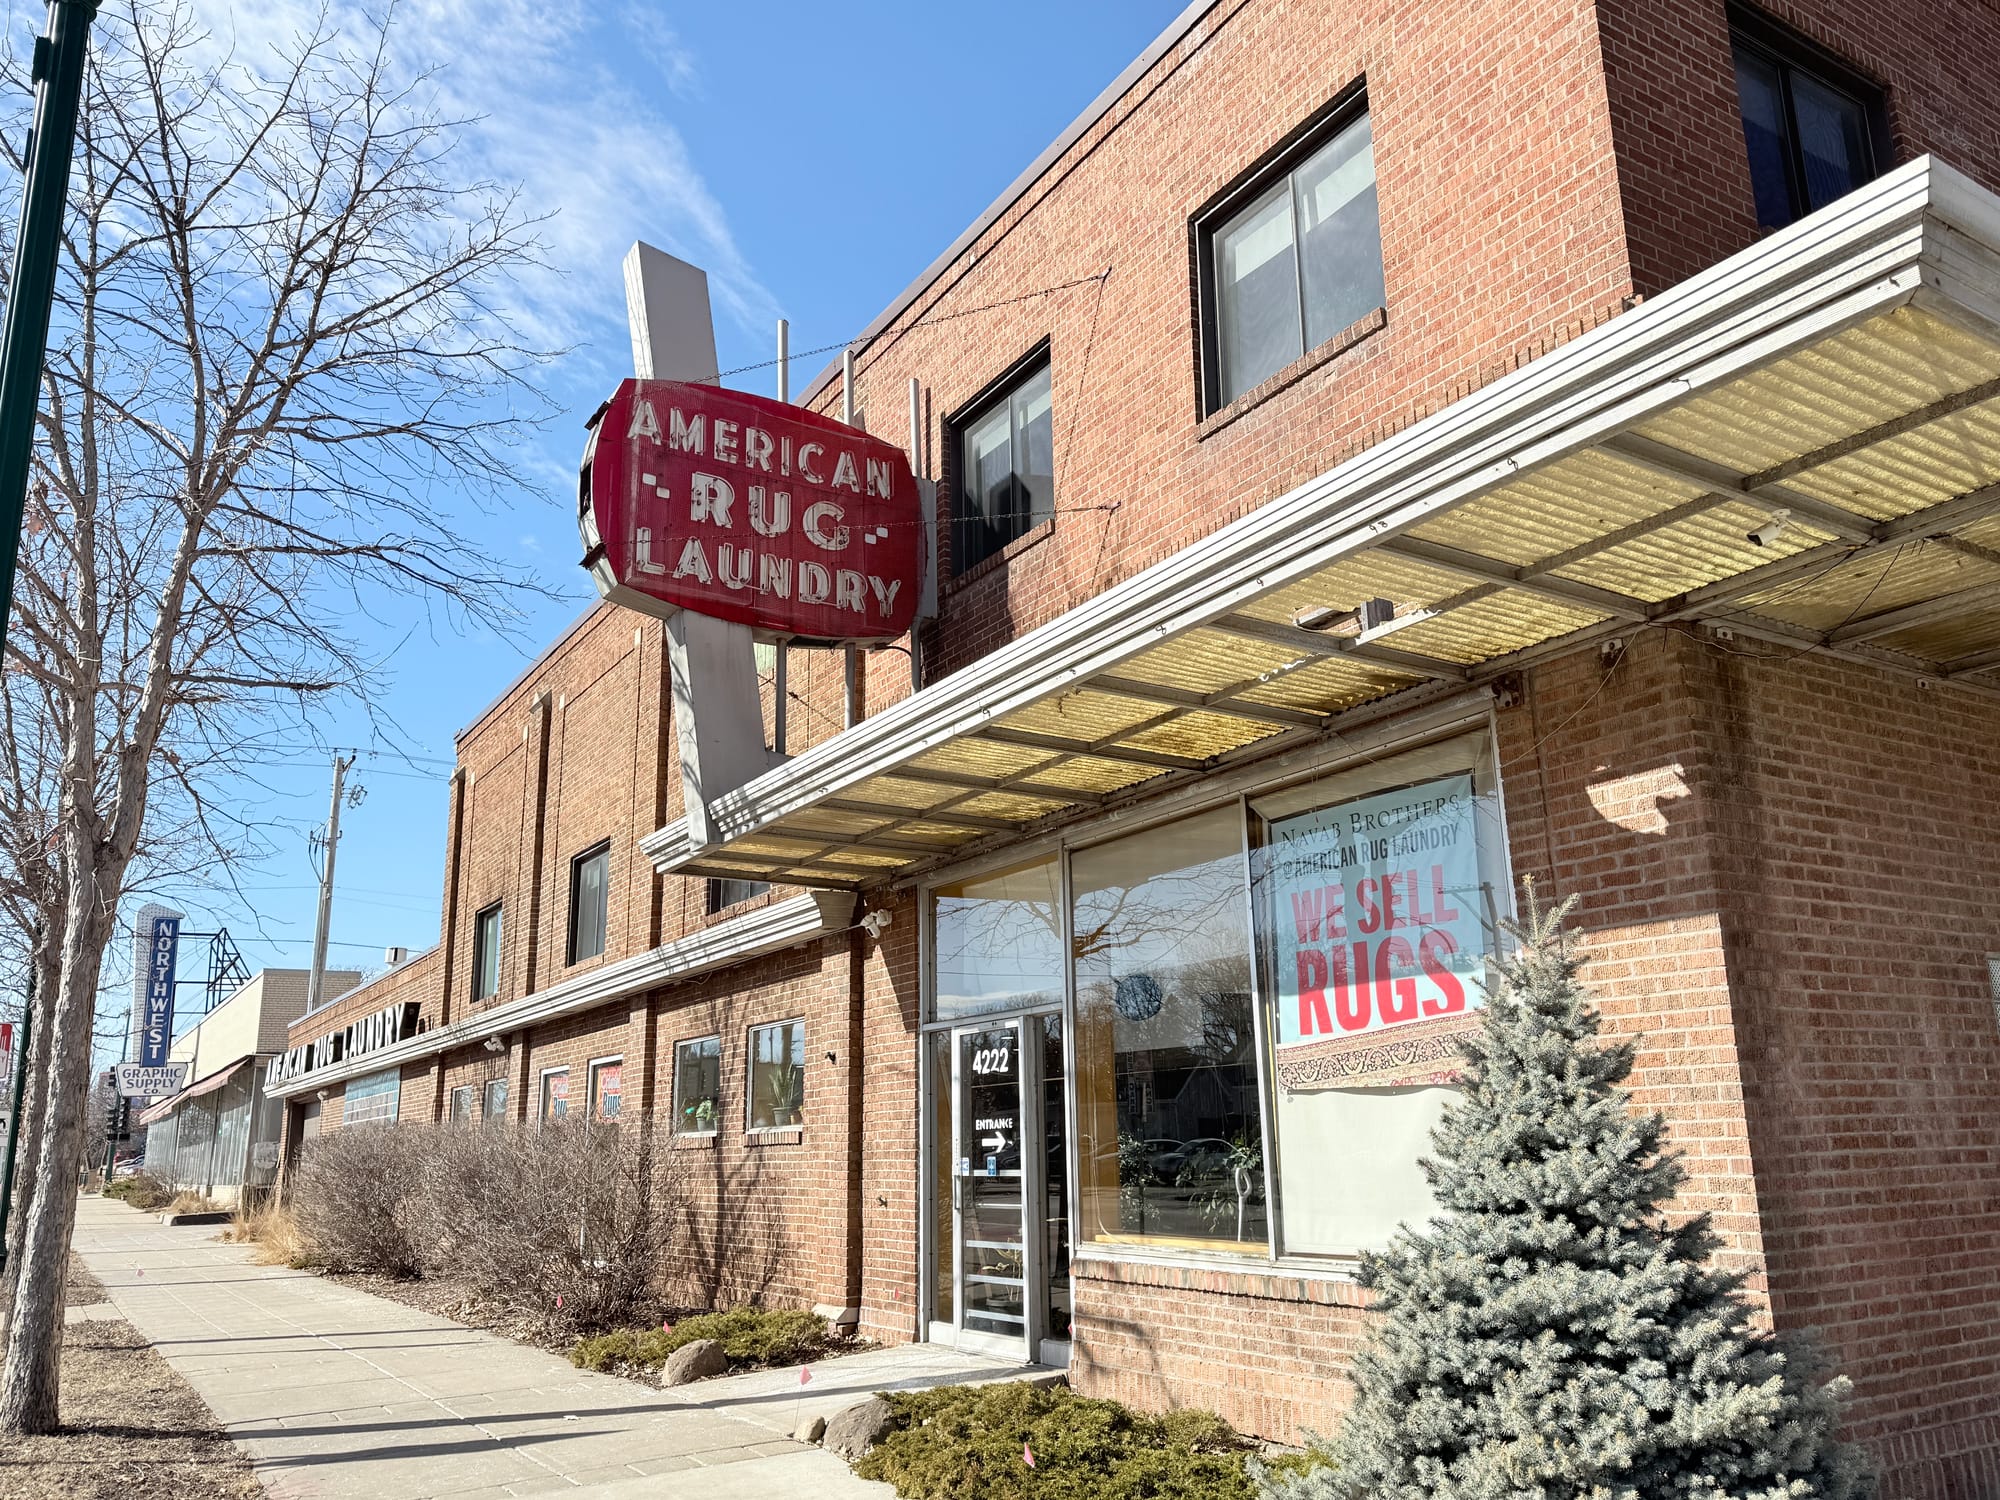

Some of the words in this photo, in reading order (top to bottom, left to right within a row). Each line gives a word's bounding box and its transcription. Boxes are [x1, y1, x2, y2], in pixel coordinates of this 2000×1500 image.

[627, 401, 894, 500] AMERICAN
[691, 471, 850, 551] RUG
[636, 527, 901, 618] LAUNDRY
[1280, 822, 1341, 850] NAVAB
[1349, 794, 1460, 834] BROTHERS
[1362, 838, 1388, 863] RUG
[1392, 823, 1460, 857] LAUNDRY
[1291, 883, 1347, 944] WE
[1356, 864, 1459, 935] SELL
[149, 921, 173, 1059] NORTHWEST
[1296, 929, 1465, 1036] RUGS
[122, 1067, 182, 1079] GRAPHIC
[126, 1078, 176, 1089] SUPPLY
[264, 1044, 308, 1087] AMERICAN
[312, 1031, 335, 1072] RUG
[342, 1002, 405, 1061] LAUNDRY
[973, 1047, 1009, 1075] 4222
[975, 1118, 1014, 1131] ENTRANCE
